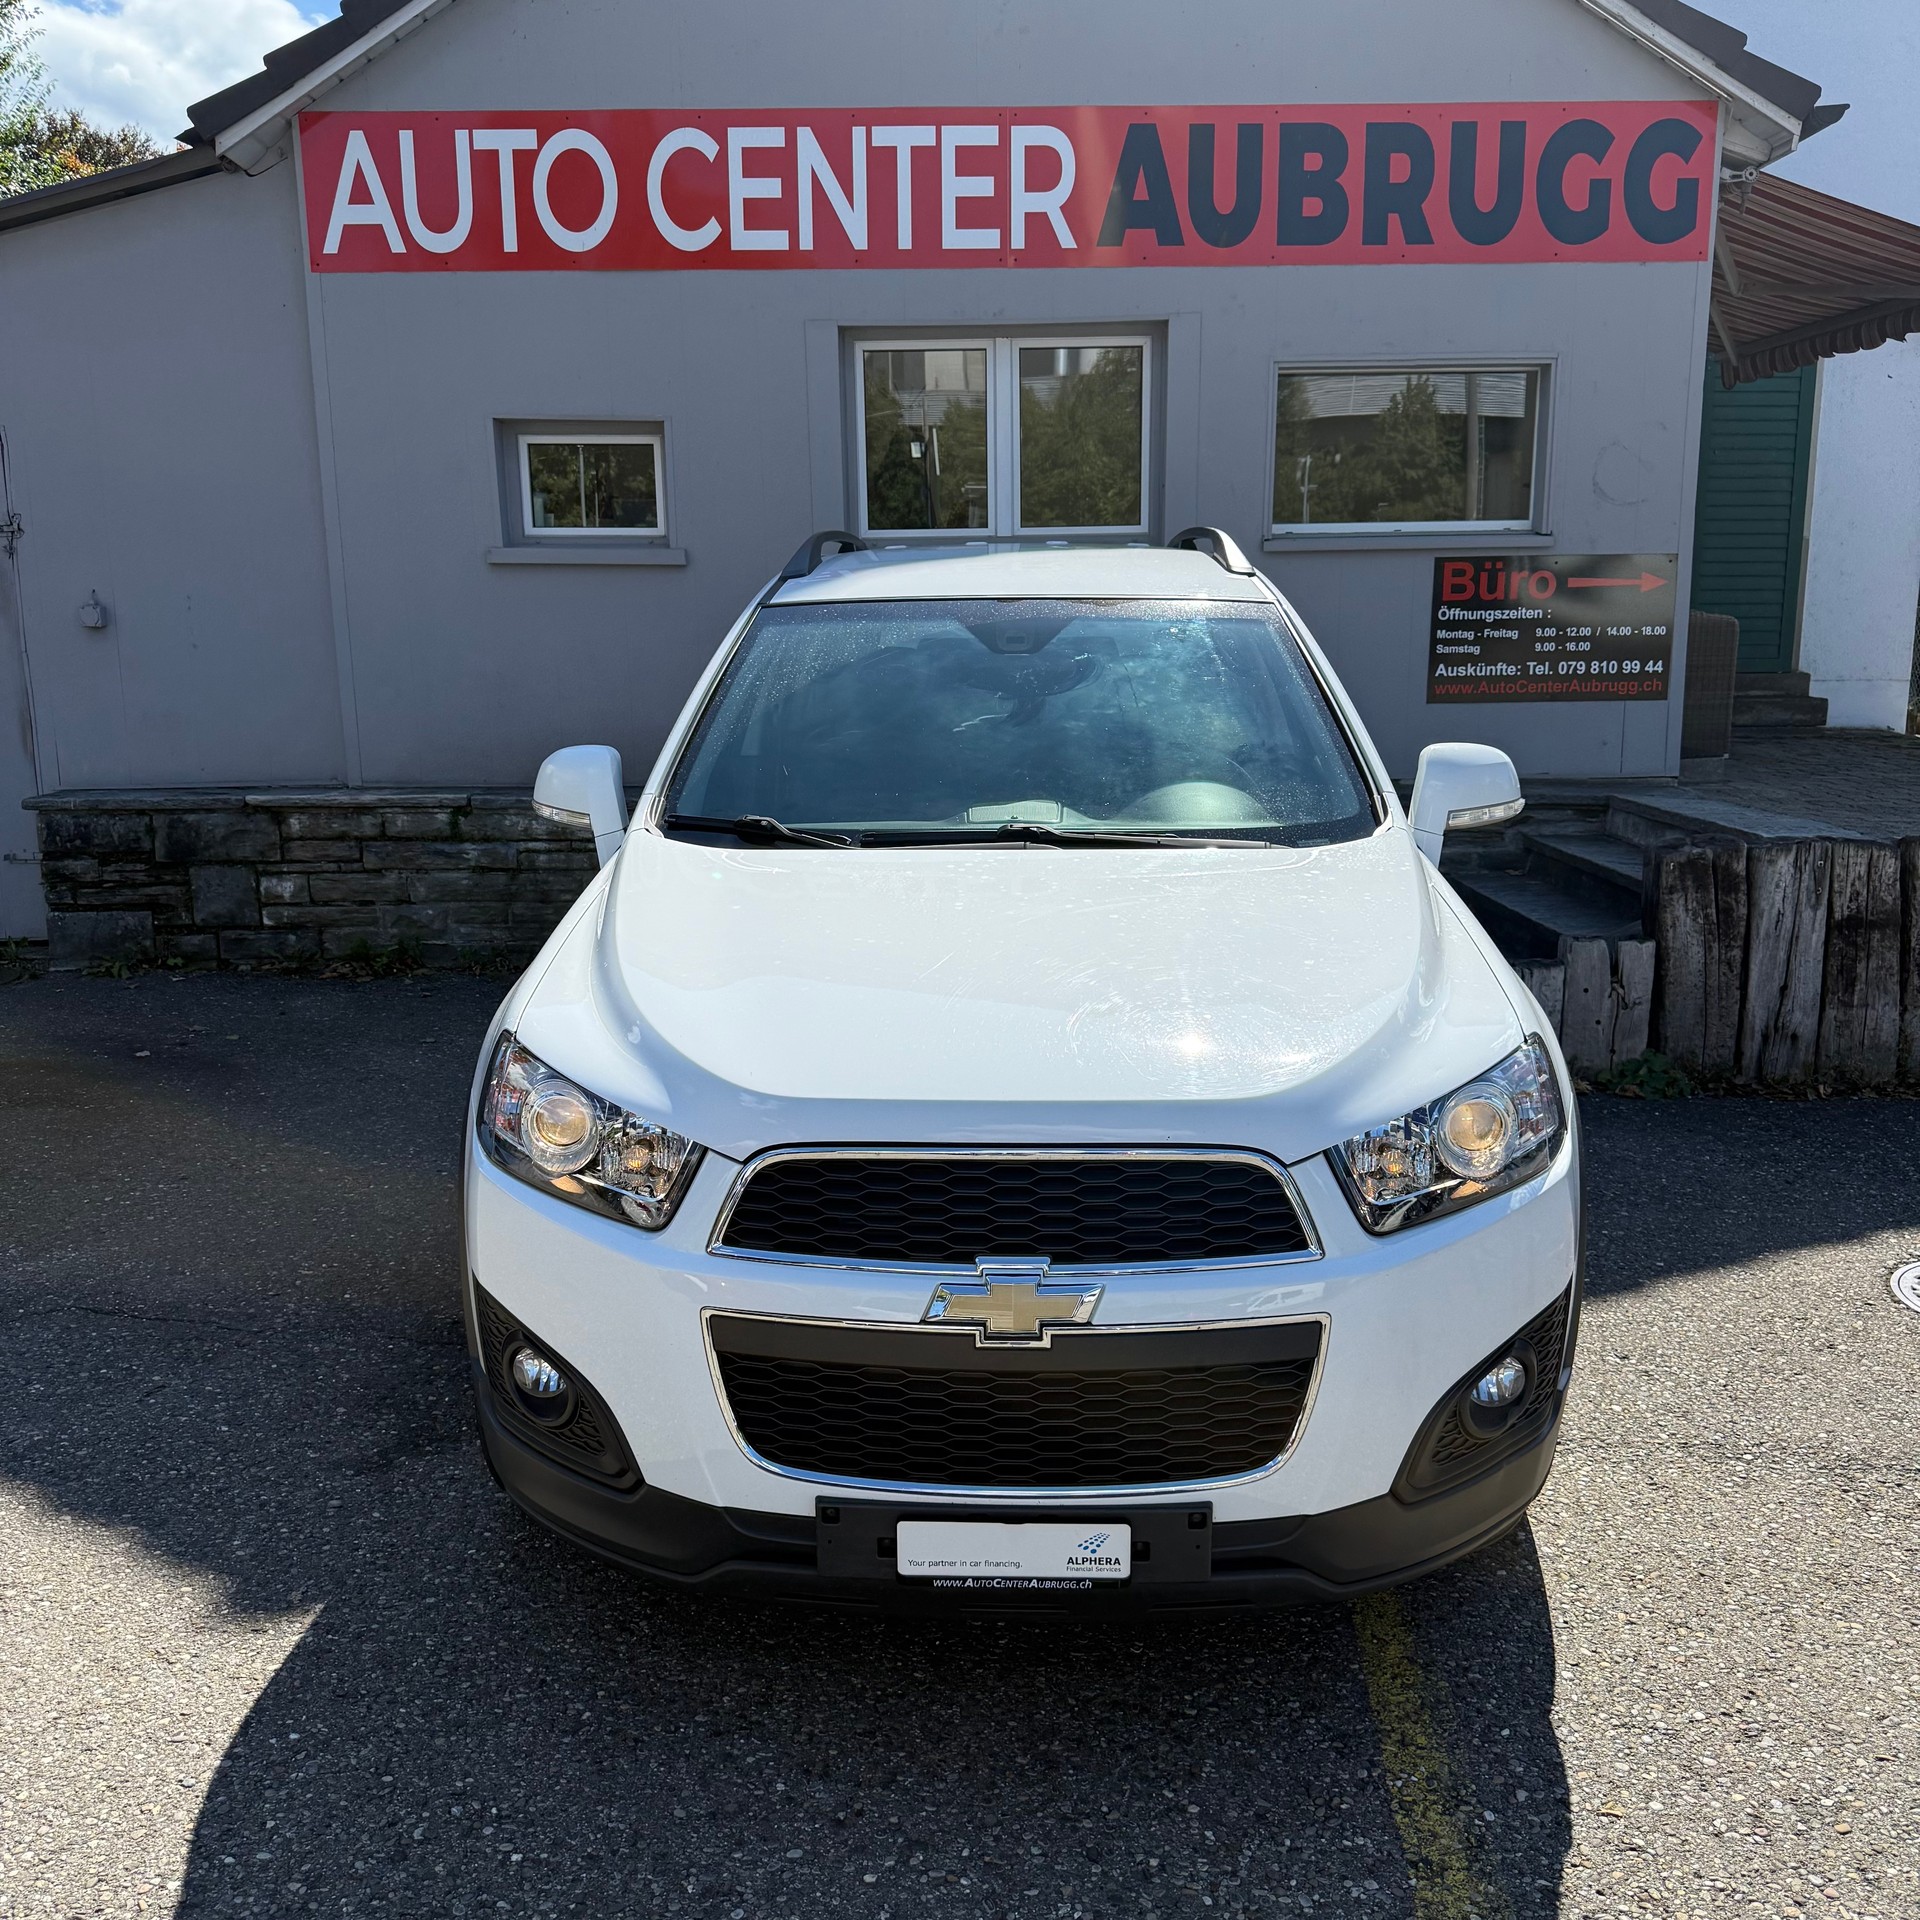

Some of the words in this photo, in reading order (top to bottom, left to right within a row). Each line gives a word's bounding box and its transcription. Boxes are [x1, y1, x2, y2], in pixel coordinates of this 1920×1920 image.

[322, 128, 619, 254] AUTO
[646, 124, 1077, 251] CENTER
[1096, 118, 1703, 248] AUBRUGG
[1442, 561, 1557, 601] Büro
[1438, 605, 1543, 622] Öffnungszeiten
[1436, 629, 1475, 640] Montag
[1483, 628, 1519, 640] Freitag
[1535, 627, 1557, 637] 9.00
[1566, 626, 1592, 637] 12.00
[1606, 626, 1632, 636] 14.00
[1641, 625, 1667, 636] 18.00
[1436, 644, 1481, 655] Samstag
[1534, 642, 1556, 652] 9.00
[1565, 641, 1591, 652] 16.00
[1435, 662, 1521, 677] Auskünfte:
[1526, 661, 1553, 676] Tel.
[1558, 661, 1586, 675] 079
[1590, 660, 1618, 675] 810
[1622, 660, 1641, 674] 99
[1644, 659, 1664, 674] 44
[1434, 678, 1663, 695] www.AutoCenterAubrugg.ch
[907, 1559, 926, 1567] Your
[928, 1560, 957, 1568] partner
[984, 1560, 1023, 1569] financing.
[1066, 1557, 1121, 1566] ALPHERA
